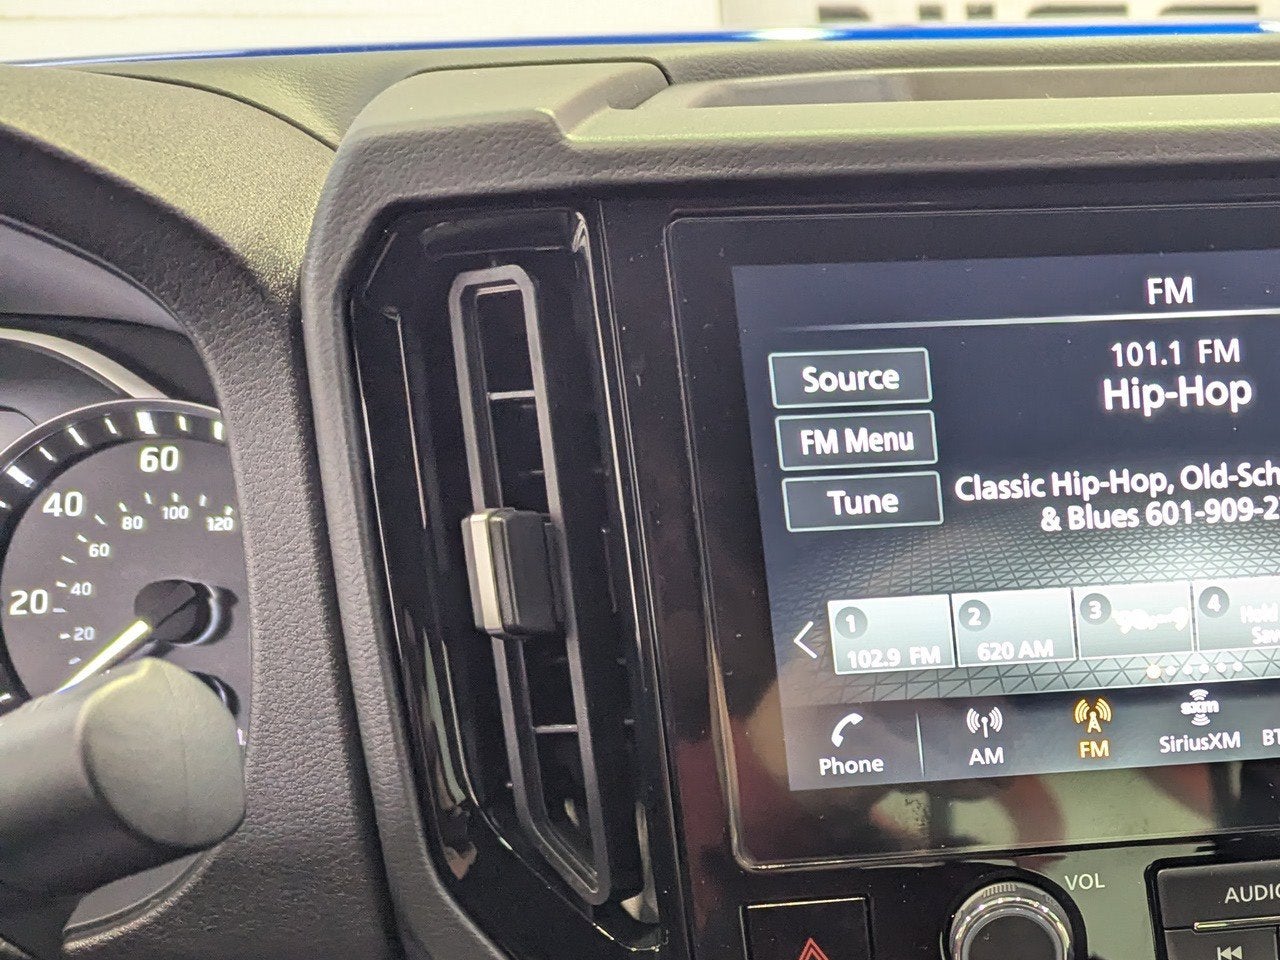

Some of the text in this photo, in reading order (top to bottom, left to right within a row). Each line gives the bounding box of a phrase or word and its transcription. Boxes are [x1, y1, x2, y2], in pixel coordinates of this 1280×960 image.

[1148, 276, 1194, 305] FM
[1111, 338, 1241, 368] 101.1 FM
[802, 365, 900, 394] Source
[1103, 375, 1253, 417] Hip-Hop
[801, 425, 914, 456] FM Menu
[139, 446, 179, 473] 60
[955, 471, 1046, 501] Classic
[1051, 467, 1175, 501] Hip-Hop,
[42, 491, 83, 518] 40
[827, 487, 899, 516] Tune
[121, 514, 144, 531] 80
[162, 505, 189, 521] 100
[207, 516, 234, 532] 120
[1041, 507, 1063, 532] &
[1068, 503, 1140, 531] Blues
[88, 542, 110, 558] 60
[70, 582, 92, 597] 40
[9, 589, 48, 617] 20
[1088, 600, 1102, 620] 3
[1206, 594, 1222, 612] 4
[1240, 602, 1279, 624] Hold
[845, 614, 857, 633] 1
[967, 607, 982, 626] 2
[847, 645, 941, 669] 102.9 FM
[977, 638, 1054, 662] 620 AM
[1079, 740, 1110, 760] FM
[1159, 731, 1241, 753] SiriusXM
[818, 756, 884, 777] Phone
[968, 747, 1005, 767] AM
[1064, 874, 1106, 892] VOL
